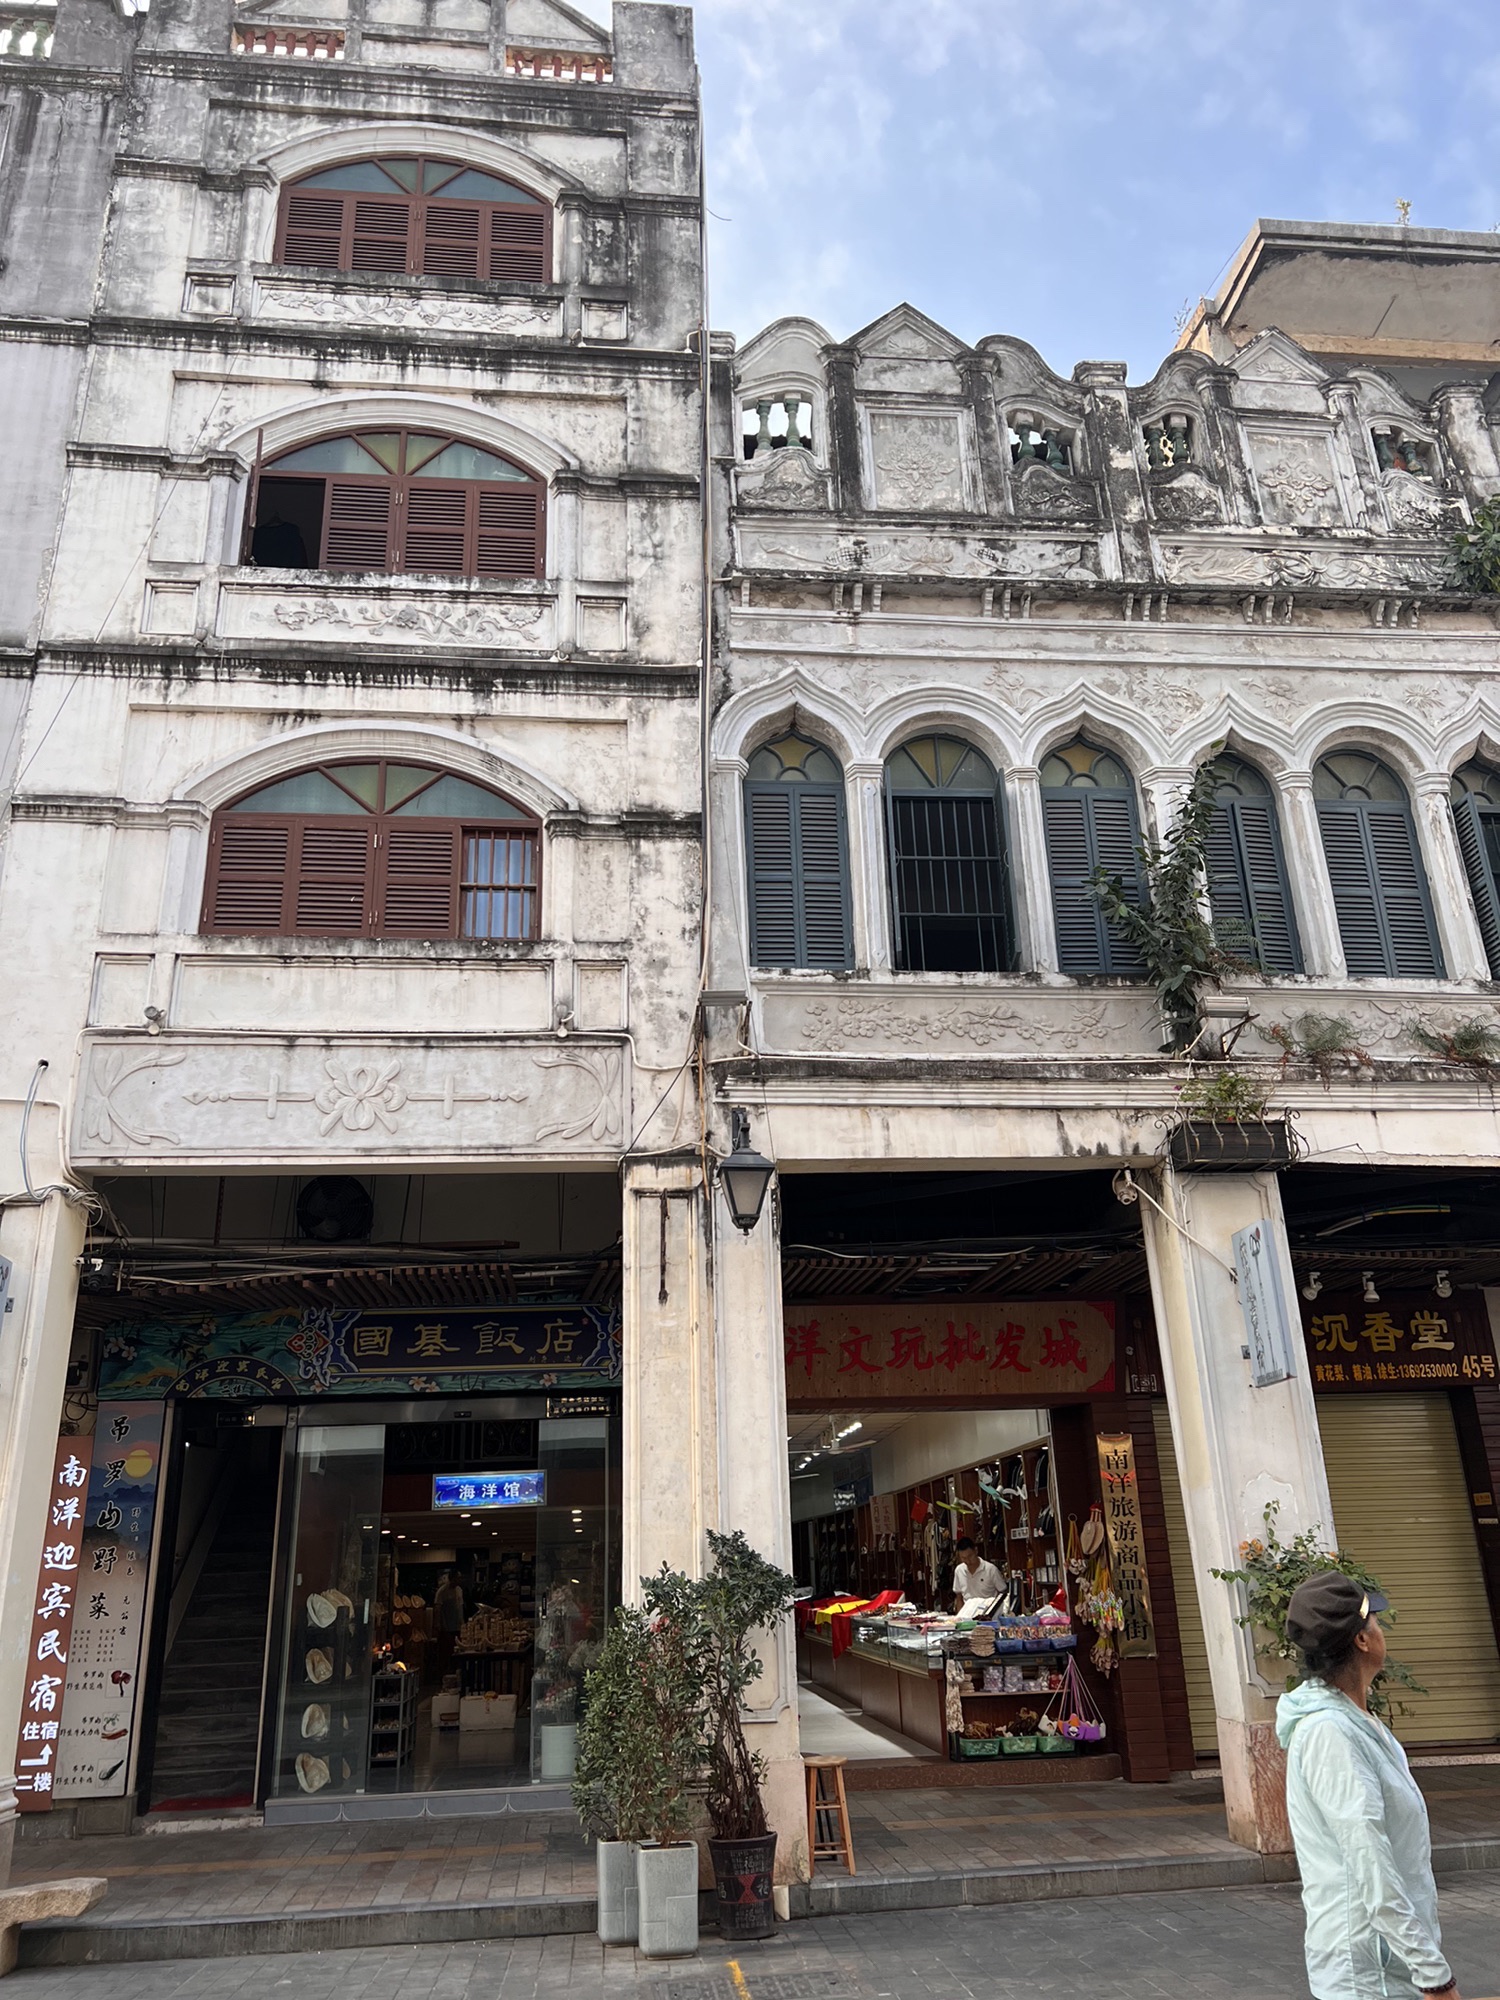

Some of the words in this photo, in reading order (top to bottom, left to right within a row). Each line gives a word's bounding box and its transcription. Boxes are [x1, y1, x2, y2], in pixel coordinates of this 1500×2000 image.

[353, 1318, 583, 1357] 國基飯店
[785, 1318, 1088, 1377] 洋文玩批发城
[1311, 1310, 1455, 1353] 沉香堂
[1462, 1355, 1496, 1379] 45号
[458, 1481, 521, 1500] 海洋馆
[89, 1415, 130, 1621] 吊罗山野菜
[1104, 1449, 1149, 1642] 南洋旅游商品小街
[30, 1455, 89, 1713] 南洋迎宾民宿
[22, 1720, 60, 1742] 住宿
[14, 1770, 53, 1793] 二楼
